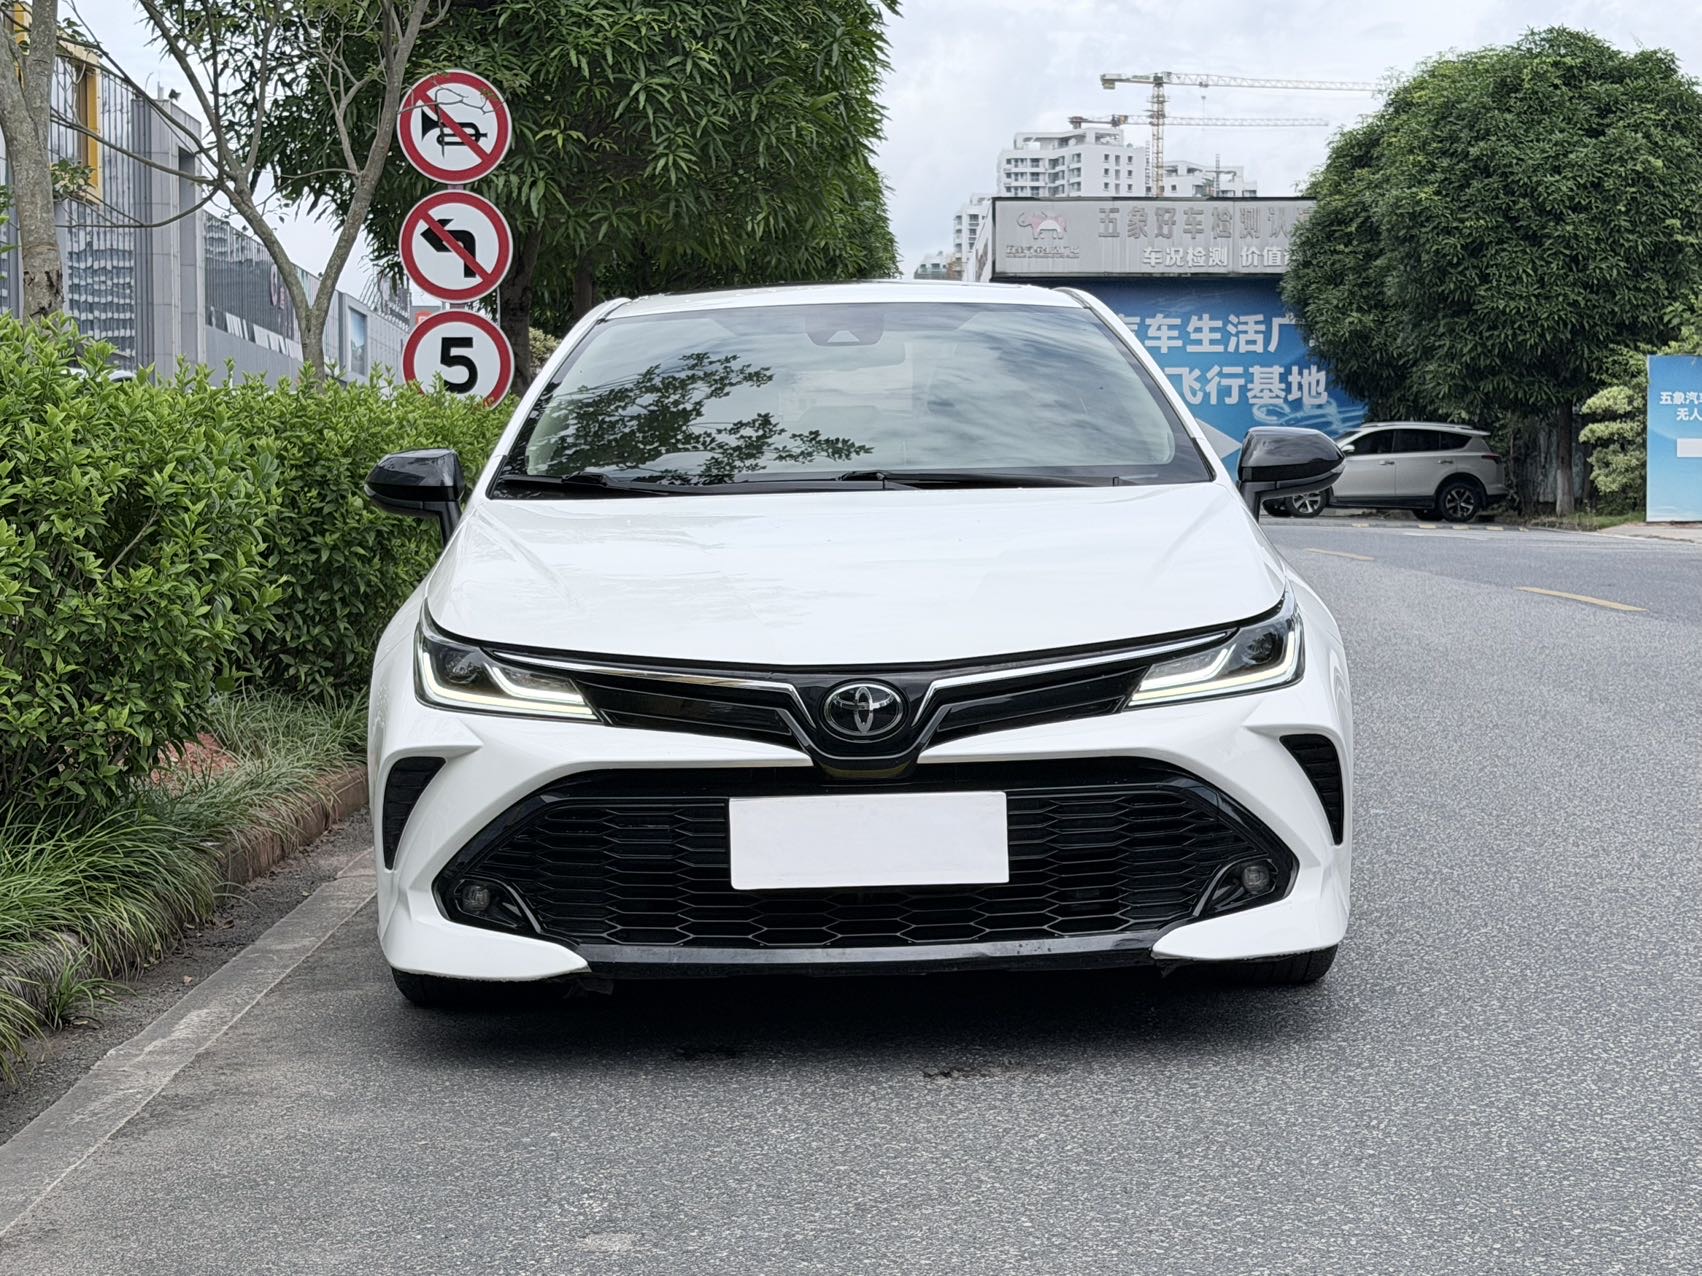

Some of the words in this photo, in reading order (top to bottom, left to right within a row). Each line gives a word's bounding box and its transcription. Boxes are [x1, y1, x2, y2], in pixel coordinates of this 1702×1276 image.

[1098, 206, 1313, 240] 五象好车检测认
[1142, 246, 1229, 268] 车况检测
[1239, 246, 1290, 268] 价值
[1118, 314, 1317, 354] 车生活广
[440, 337, 479, 394] 5
[1164, 365, 1328, 405] 飞行基地
[1659, 391, 1702, 405] 五象汽
[1676, 407, 1702, 421] 无人
